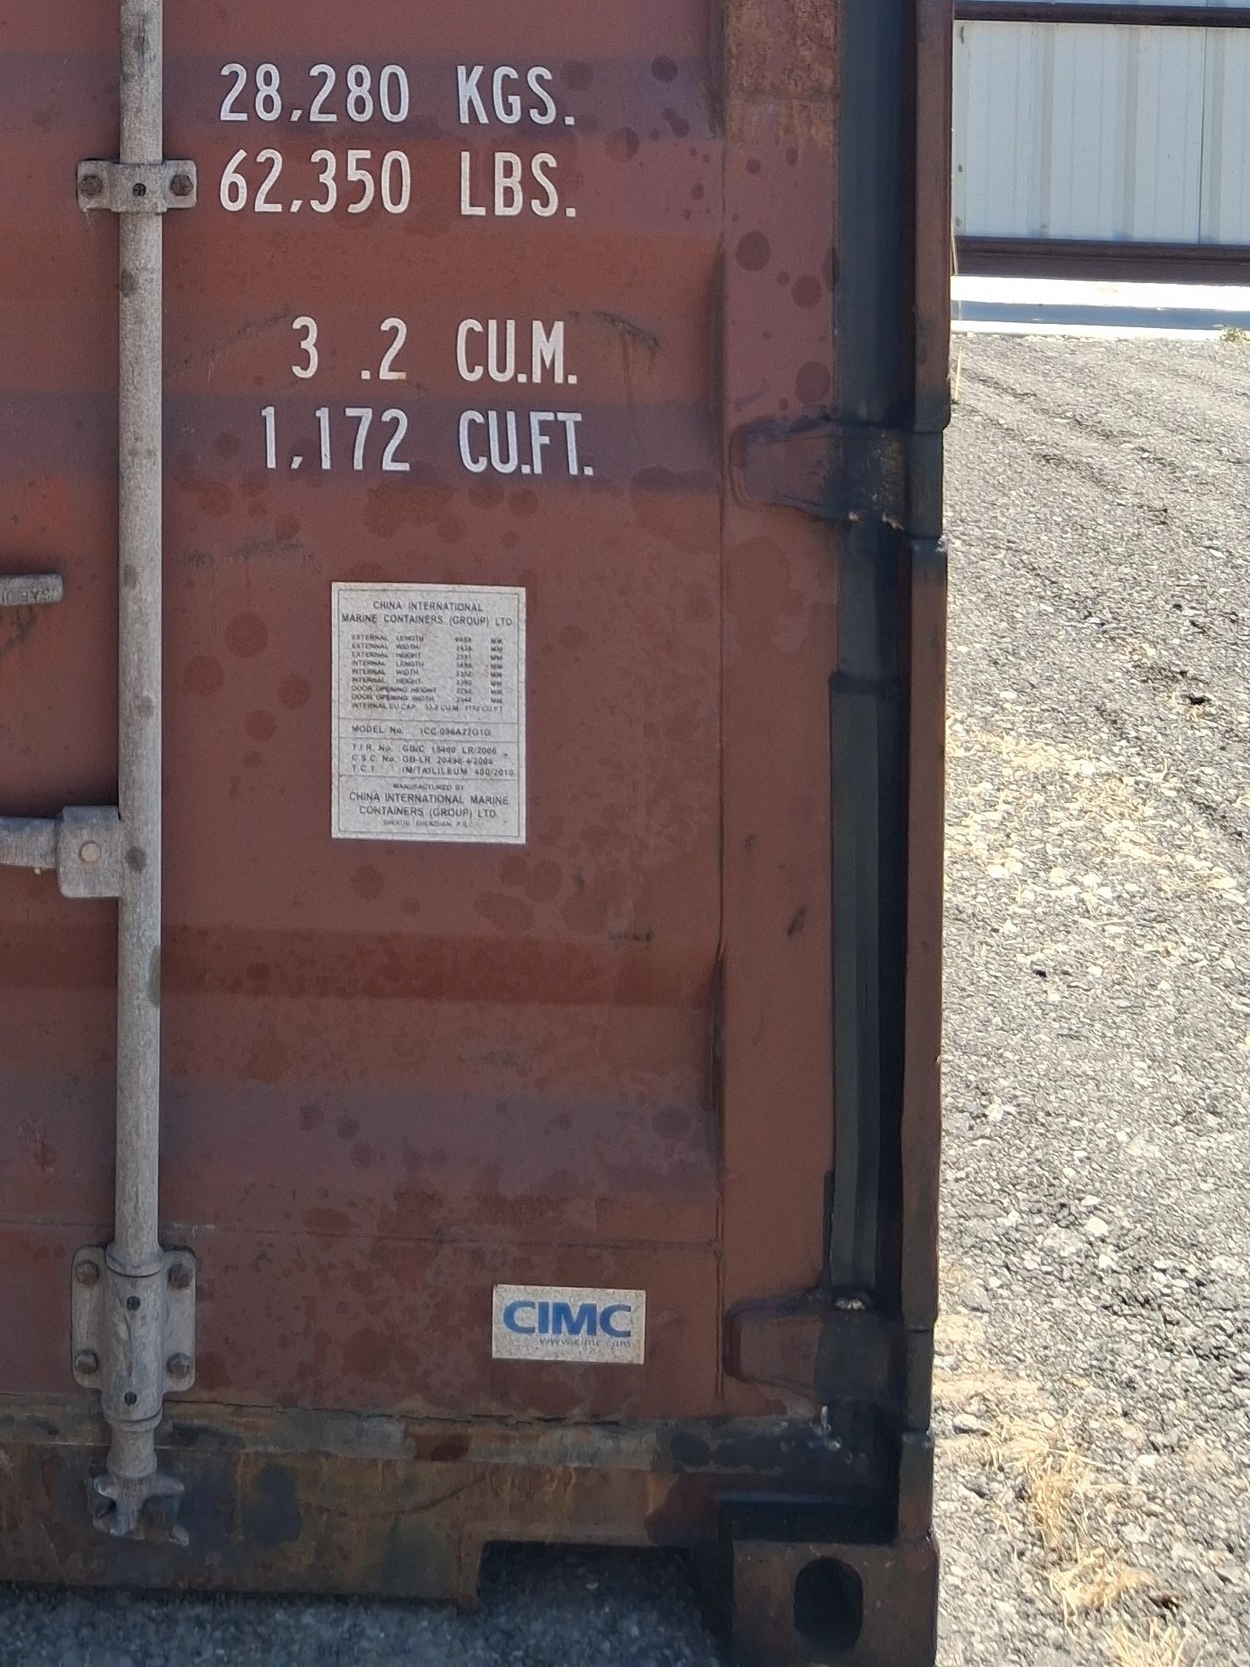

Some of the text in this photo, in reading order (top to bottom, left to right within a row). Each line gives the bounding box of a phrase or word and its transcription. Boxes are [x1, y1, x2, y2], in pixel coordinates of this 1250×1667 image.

[220, 63, 575, 126] 28,280 KGS.
[219, 148, 576, 218] 62,350 LBS.
[456, 318, 578, 385] CU.M.
[261, 406, 594, 476] 1,172 CU.FT.
[373, 600, 483, 612] CHINA INTERNATIONAL
[341, 613, 378, 624] MARINE
[383, 614, 444, 625] CONTAINERS
[449, 615, 490, 628] (GROUP)
[351, 724, 385, 734] MODEL
[350, 790, 510, 807] CHINA INTERNATIONAL MARINE
[359, 804, 425, 818] CONTAINERS
[429, 806, 473, 820] (GROUP)
[502, 1299, 632, 1339] CIMC
[538, 1336, 632, 1349] www.cimc.com
